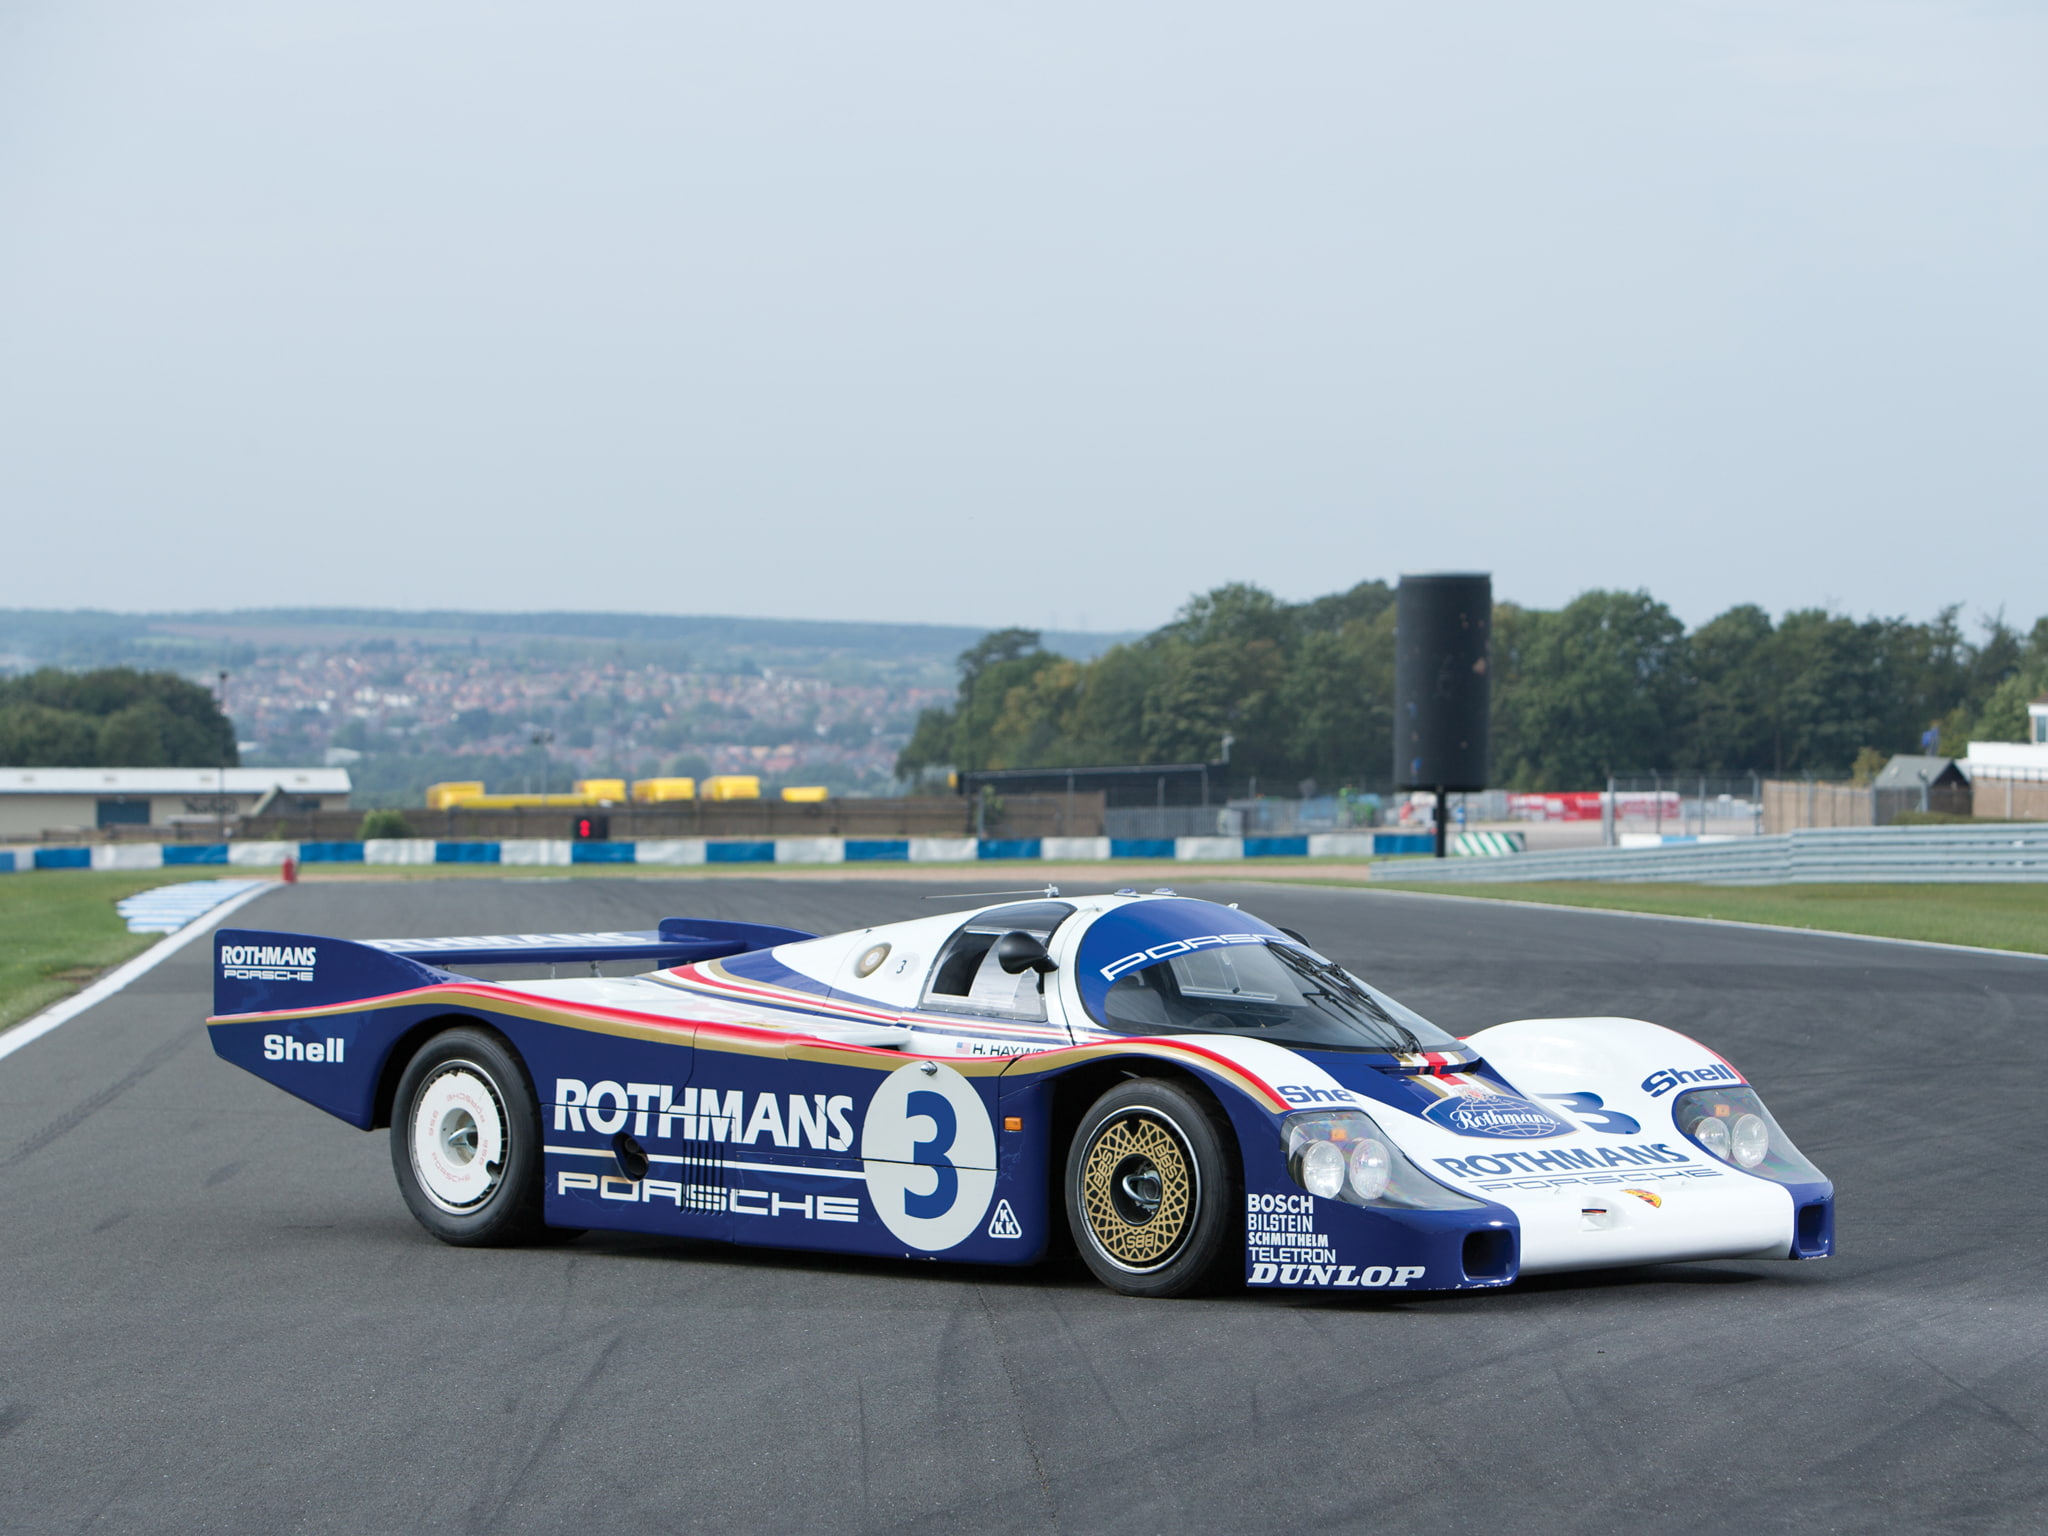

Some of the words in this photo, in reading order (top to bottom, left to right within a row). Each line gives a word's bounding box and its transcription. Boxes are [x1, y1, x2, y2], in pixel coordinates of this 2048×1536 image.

[221, 945, 316, 966] ROTHMANS
[896, 959, 907, 975] 3
[223, 969, 314, 982] PORSCHE
[263, 1034, 344, 1063] Shell
[973, 1043, 986, 1055] H.
[1641, 1063, 1737, 1098] Shell
[554, 1078, 854, 1152] ROTHMANS
[904, 1090, 959, 1220] 3
[1155, 1143, 1177, 1180] BBS
[1432, 1143, 1691, 1178] ROTHMANS
[1093, 1149, 1113, 1189] BBS
[1477, 1168, 1724, 1192] PORSCHE
[558, 1171, 859, 1223] PORSCHE
[1247, 1193, 1314, 1214] BOSCH
[1247, 1214, 1313, 1233] BILSTEIN
[1126, 1233, 1154, 1249] BBS
[1248, 1232, 1329, 1248] SCHMITTHELM
[1248, 1247, 1336, 1264] TELETRON
[1247, 1262, 1426, 1287] DUNLOP
